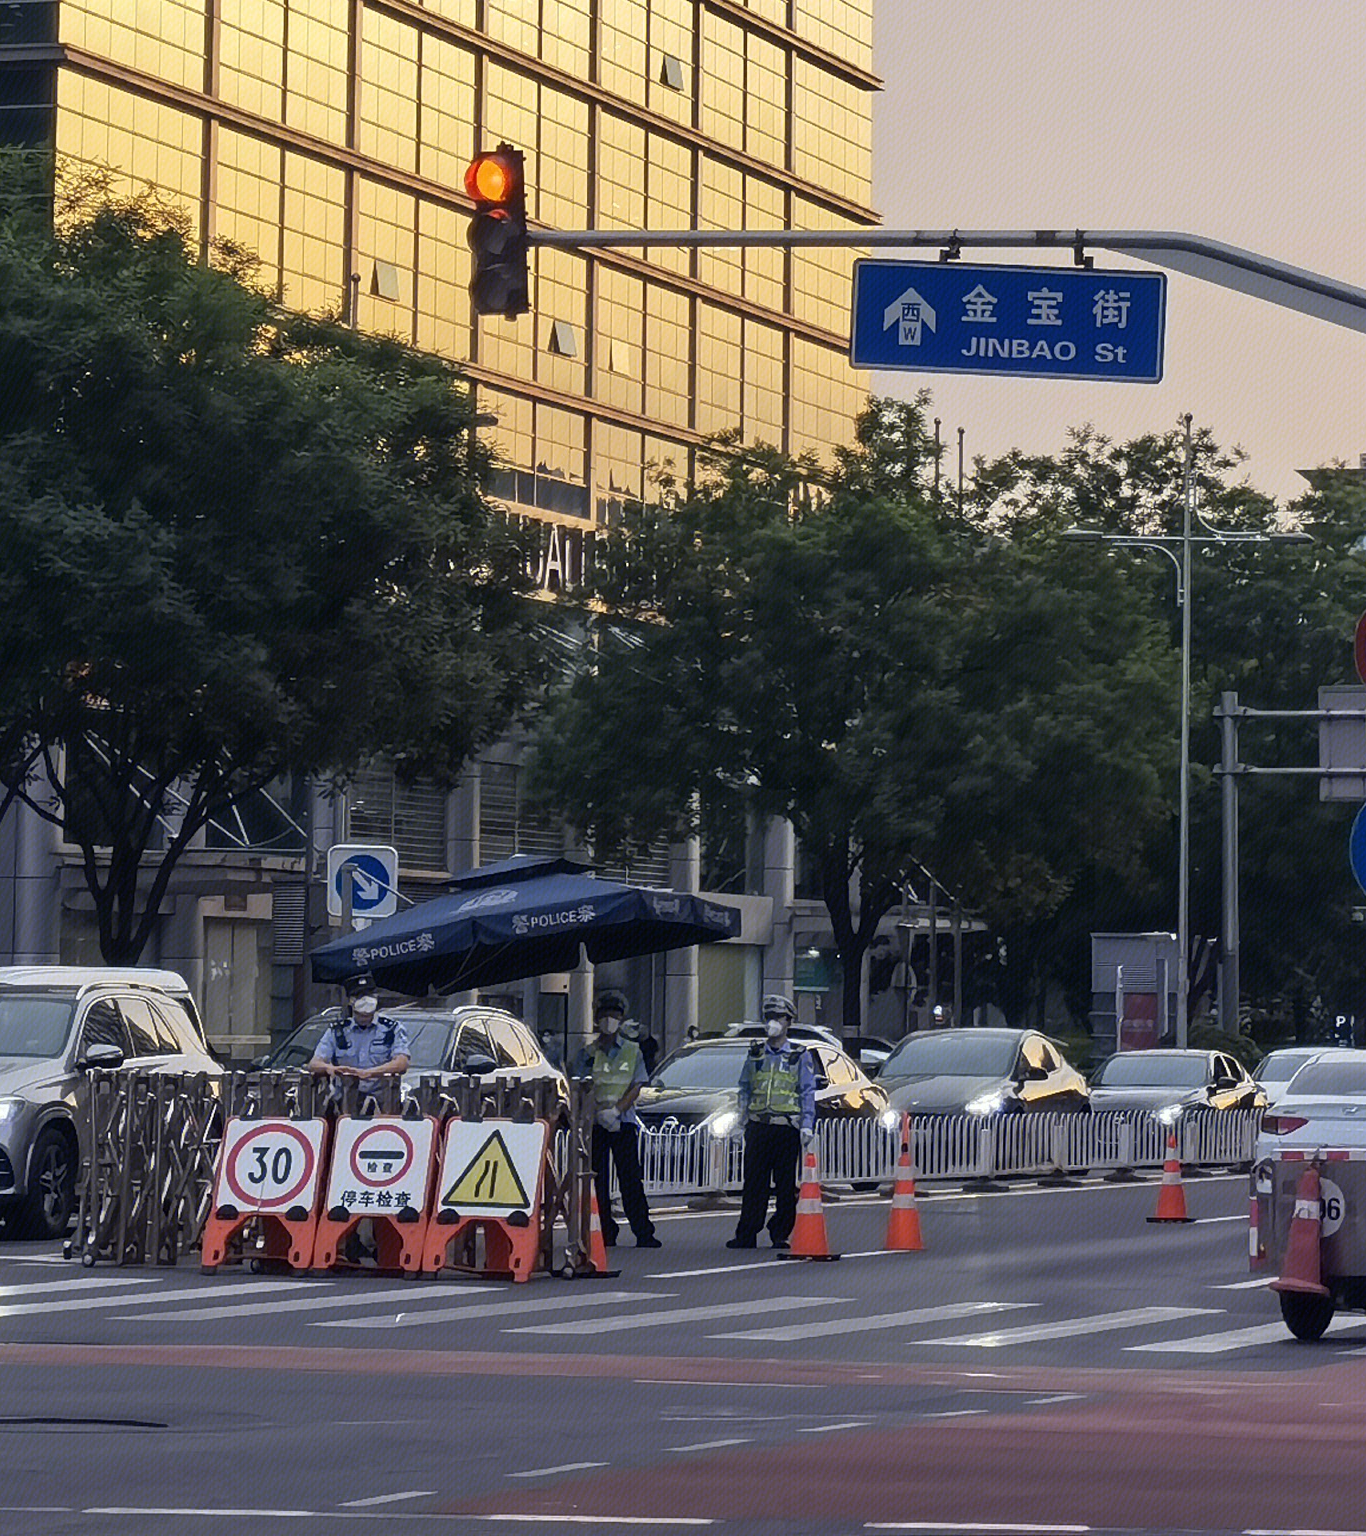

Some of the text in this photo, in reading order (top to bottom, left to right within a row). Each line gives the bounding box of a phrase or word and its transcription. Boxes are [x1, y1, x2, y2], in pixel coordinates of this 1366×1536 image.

[900, 302, 922, 323] 西
[960, 284, 1132, 329] 金宝街
[902, 326, 918, 343] W
[961, 336, 1128, 364] JINBAO St
[530, 910, 578, 929] POLICE
[370, 939, 417, 961] POLICE
[247, 1146, 293, 1185] 30
[340, 1189, 412, 1208] 停车检查
